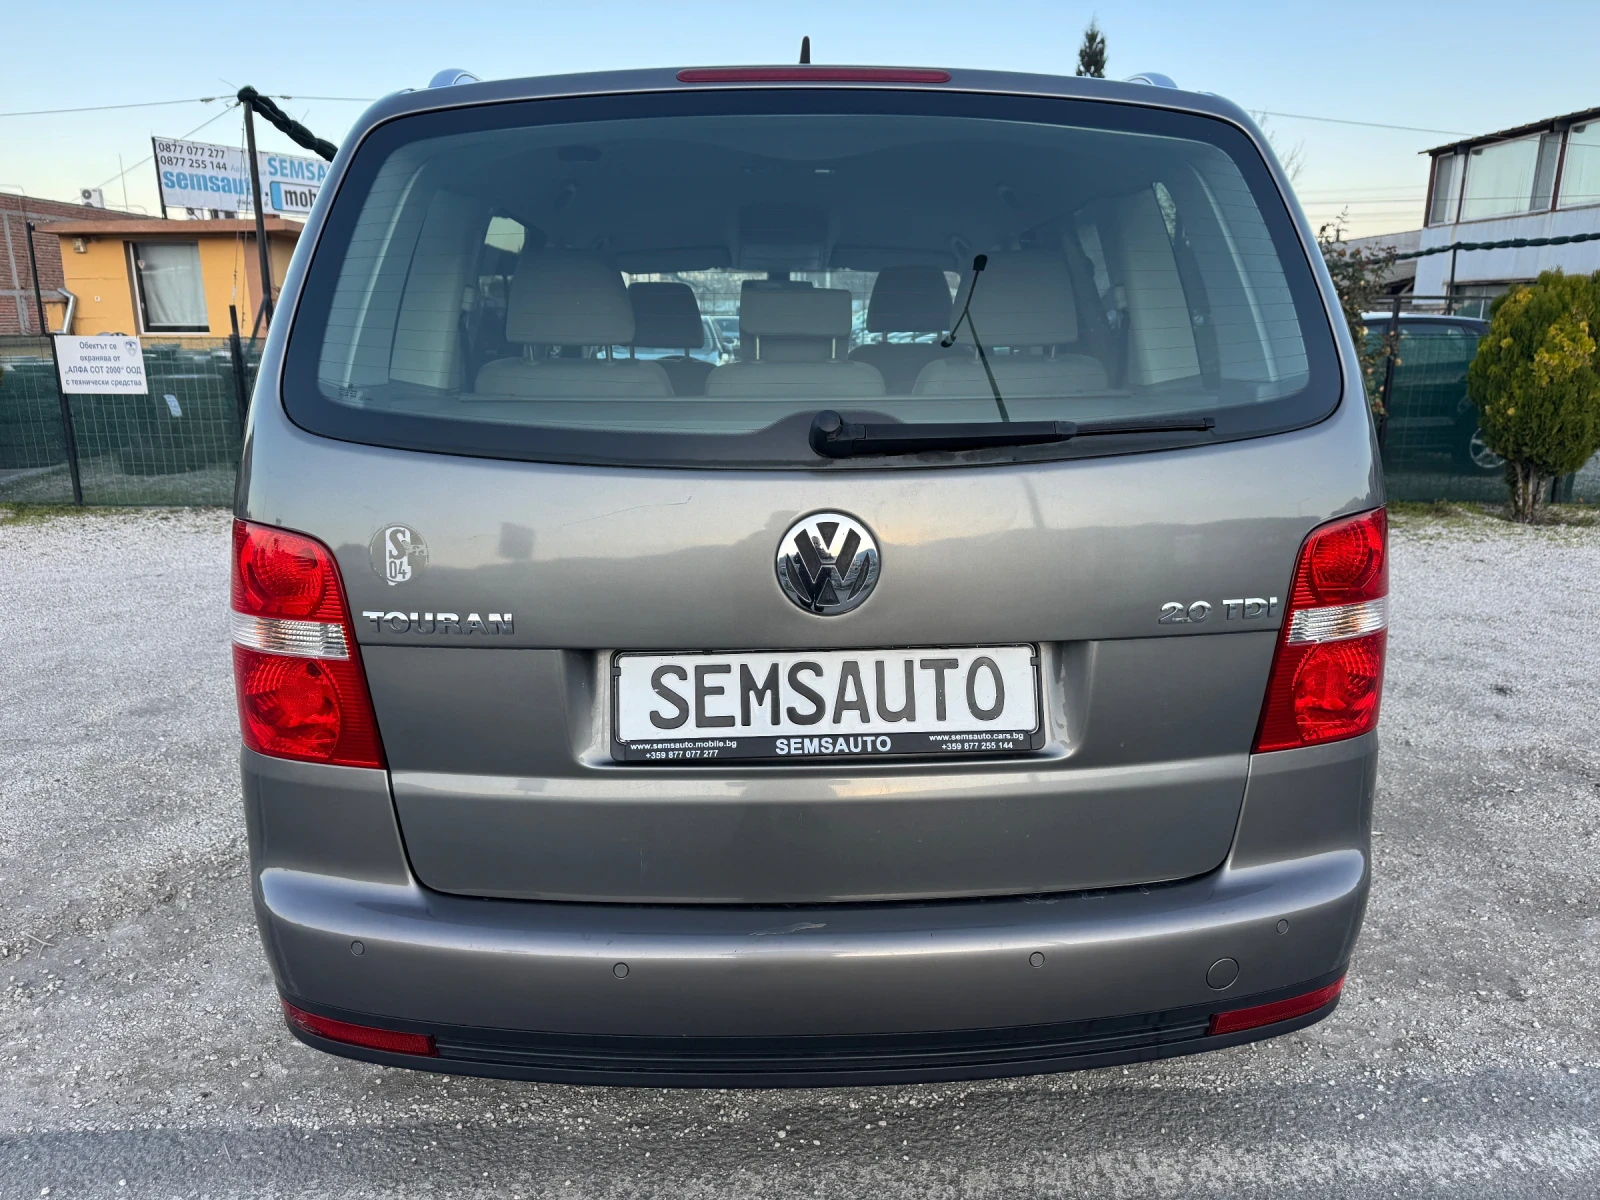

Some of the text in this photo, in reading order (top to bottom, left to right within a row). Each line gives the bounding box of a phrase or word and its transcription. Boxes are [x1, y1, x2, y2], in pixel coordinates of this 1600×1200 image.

[158, 142, 225, 159] 0877 077 277
[160, 155, 185, 167] 0877
[188, 158, 207, 169] 255
[209, 161, 227, 171] 144
[79, 342, 107, 350] Обектът
[80, 355, 112, 363] охранява
[90, 365, 104, 374] СОТ
[126, 366, 142, 375] ООД
[388, 528, 407, 560] S
[388, 560, 408, 579] 04
[777, 511, 880, 614] VW
[1222, 596, 1278, 620] TDI
[362, 611, 515, 635] TOURAN
[649, 656, 1006, 730] SEMSAUTO
[630, 739, 737, 750] www.semsauto.mobile.bg
[928, 732, 1024, 741] www.semsauto.cars.bg
[775, 735, 892, 755] SEMSAUTO
[941, 741, 1013, 750] +359 877 255 144
[645, 749, 719, 759] +359 877 077 277
